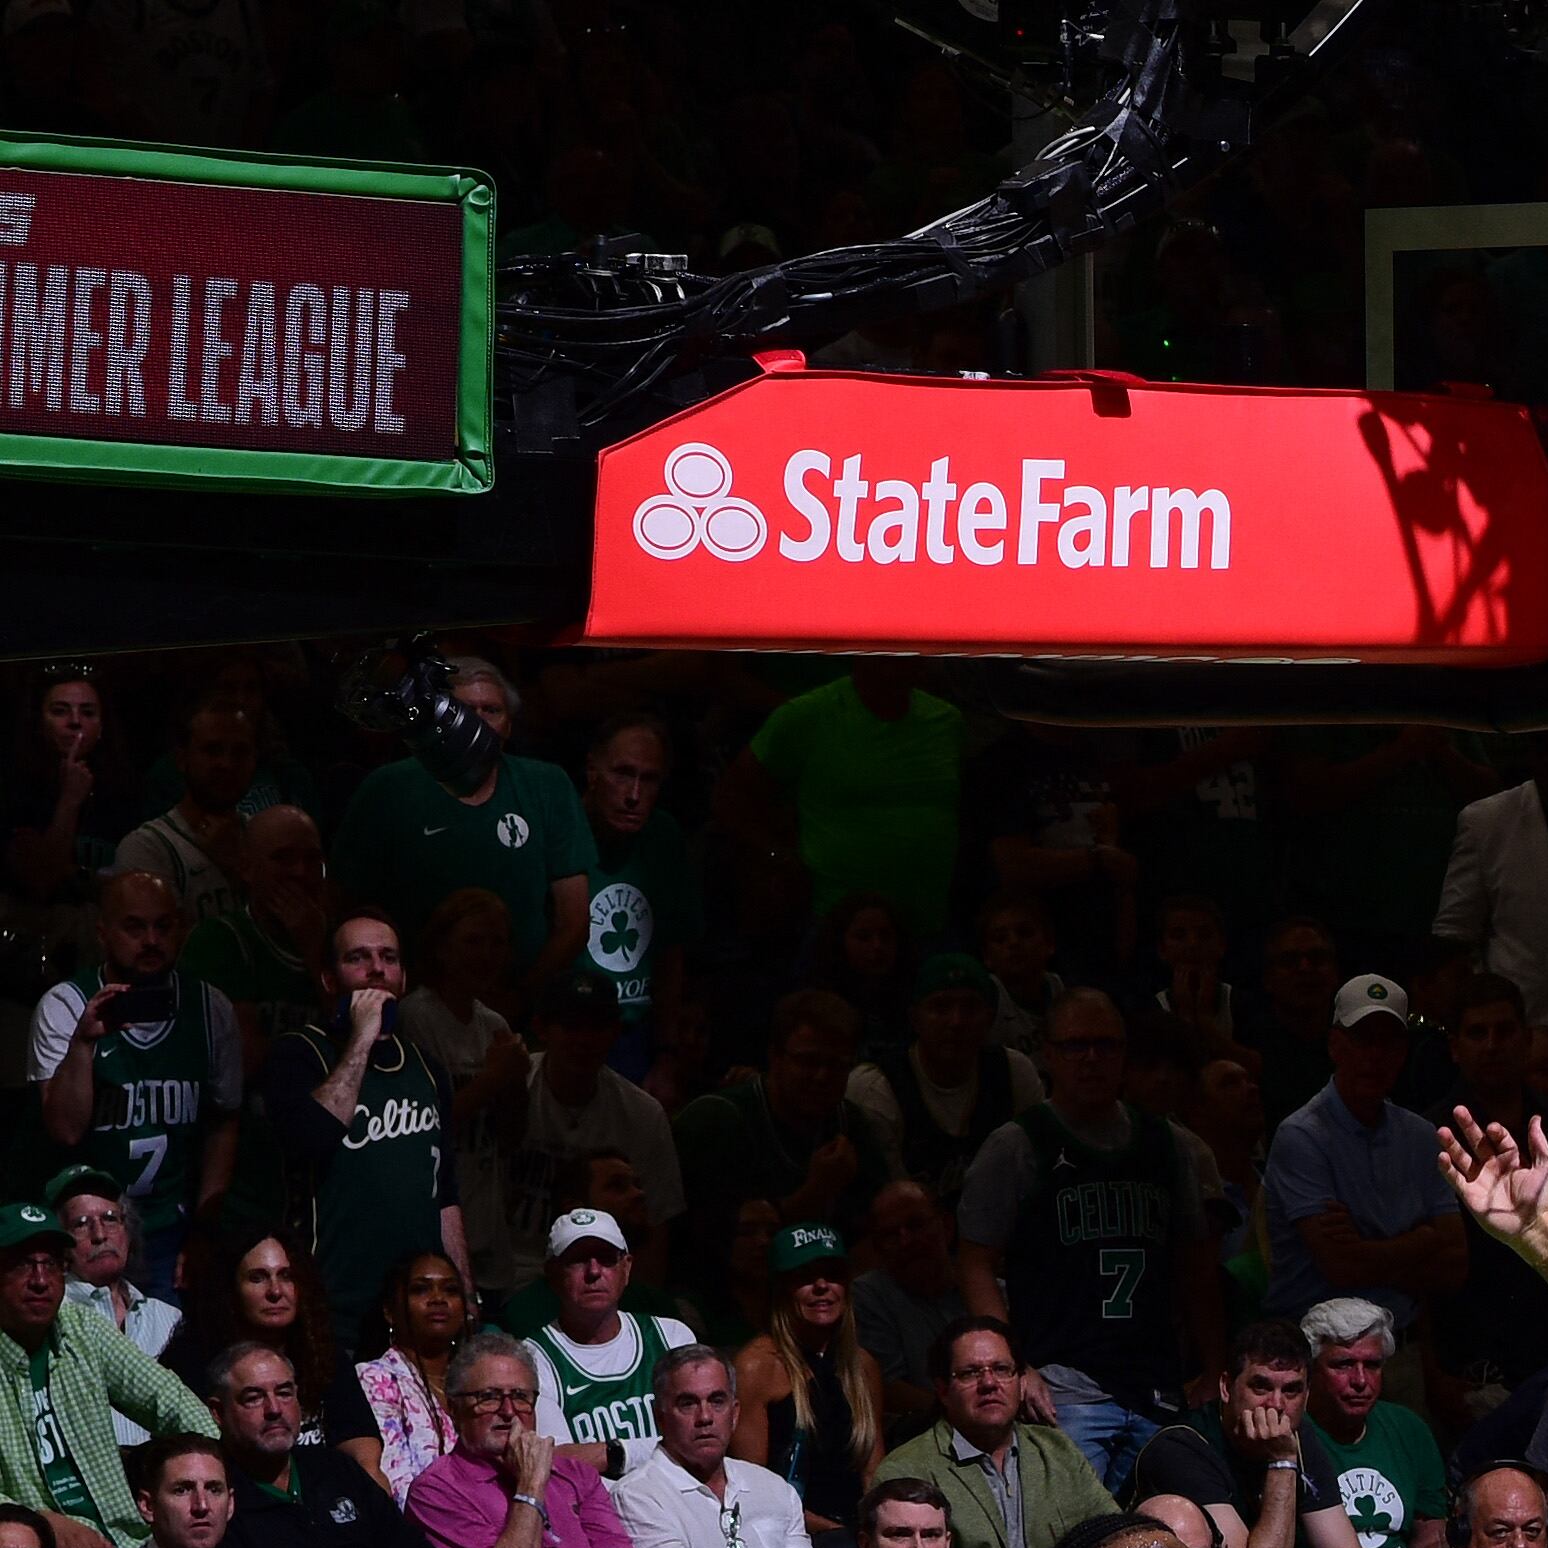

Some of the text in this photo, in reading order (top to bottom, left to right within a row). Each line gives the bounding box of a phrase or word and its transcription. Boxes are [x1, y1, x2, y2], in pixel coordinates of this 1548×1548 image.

[0, 262, 410, 435] MER LEAGUE
[591, 889, 649, 927] CELTICS
[127, 1133, 169, 1199] 7
[1056, 1180, 1166, 1246] CELTIC
[1099, 1248, 1147, 1319] 7
[1339, 1474, 1396, 1509] ELTICS
